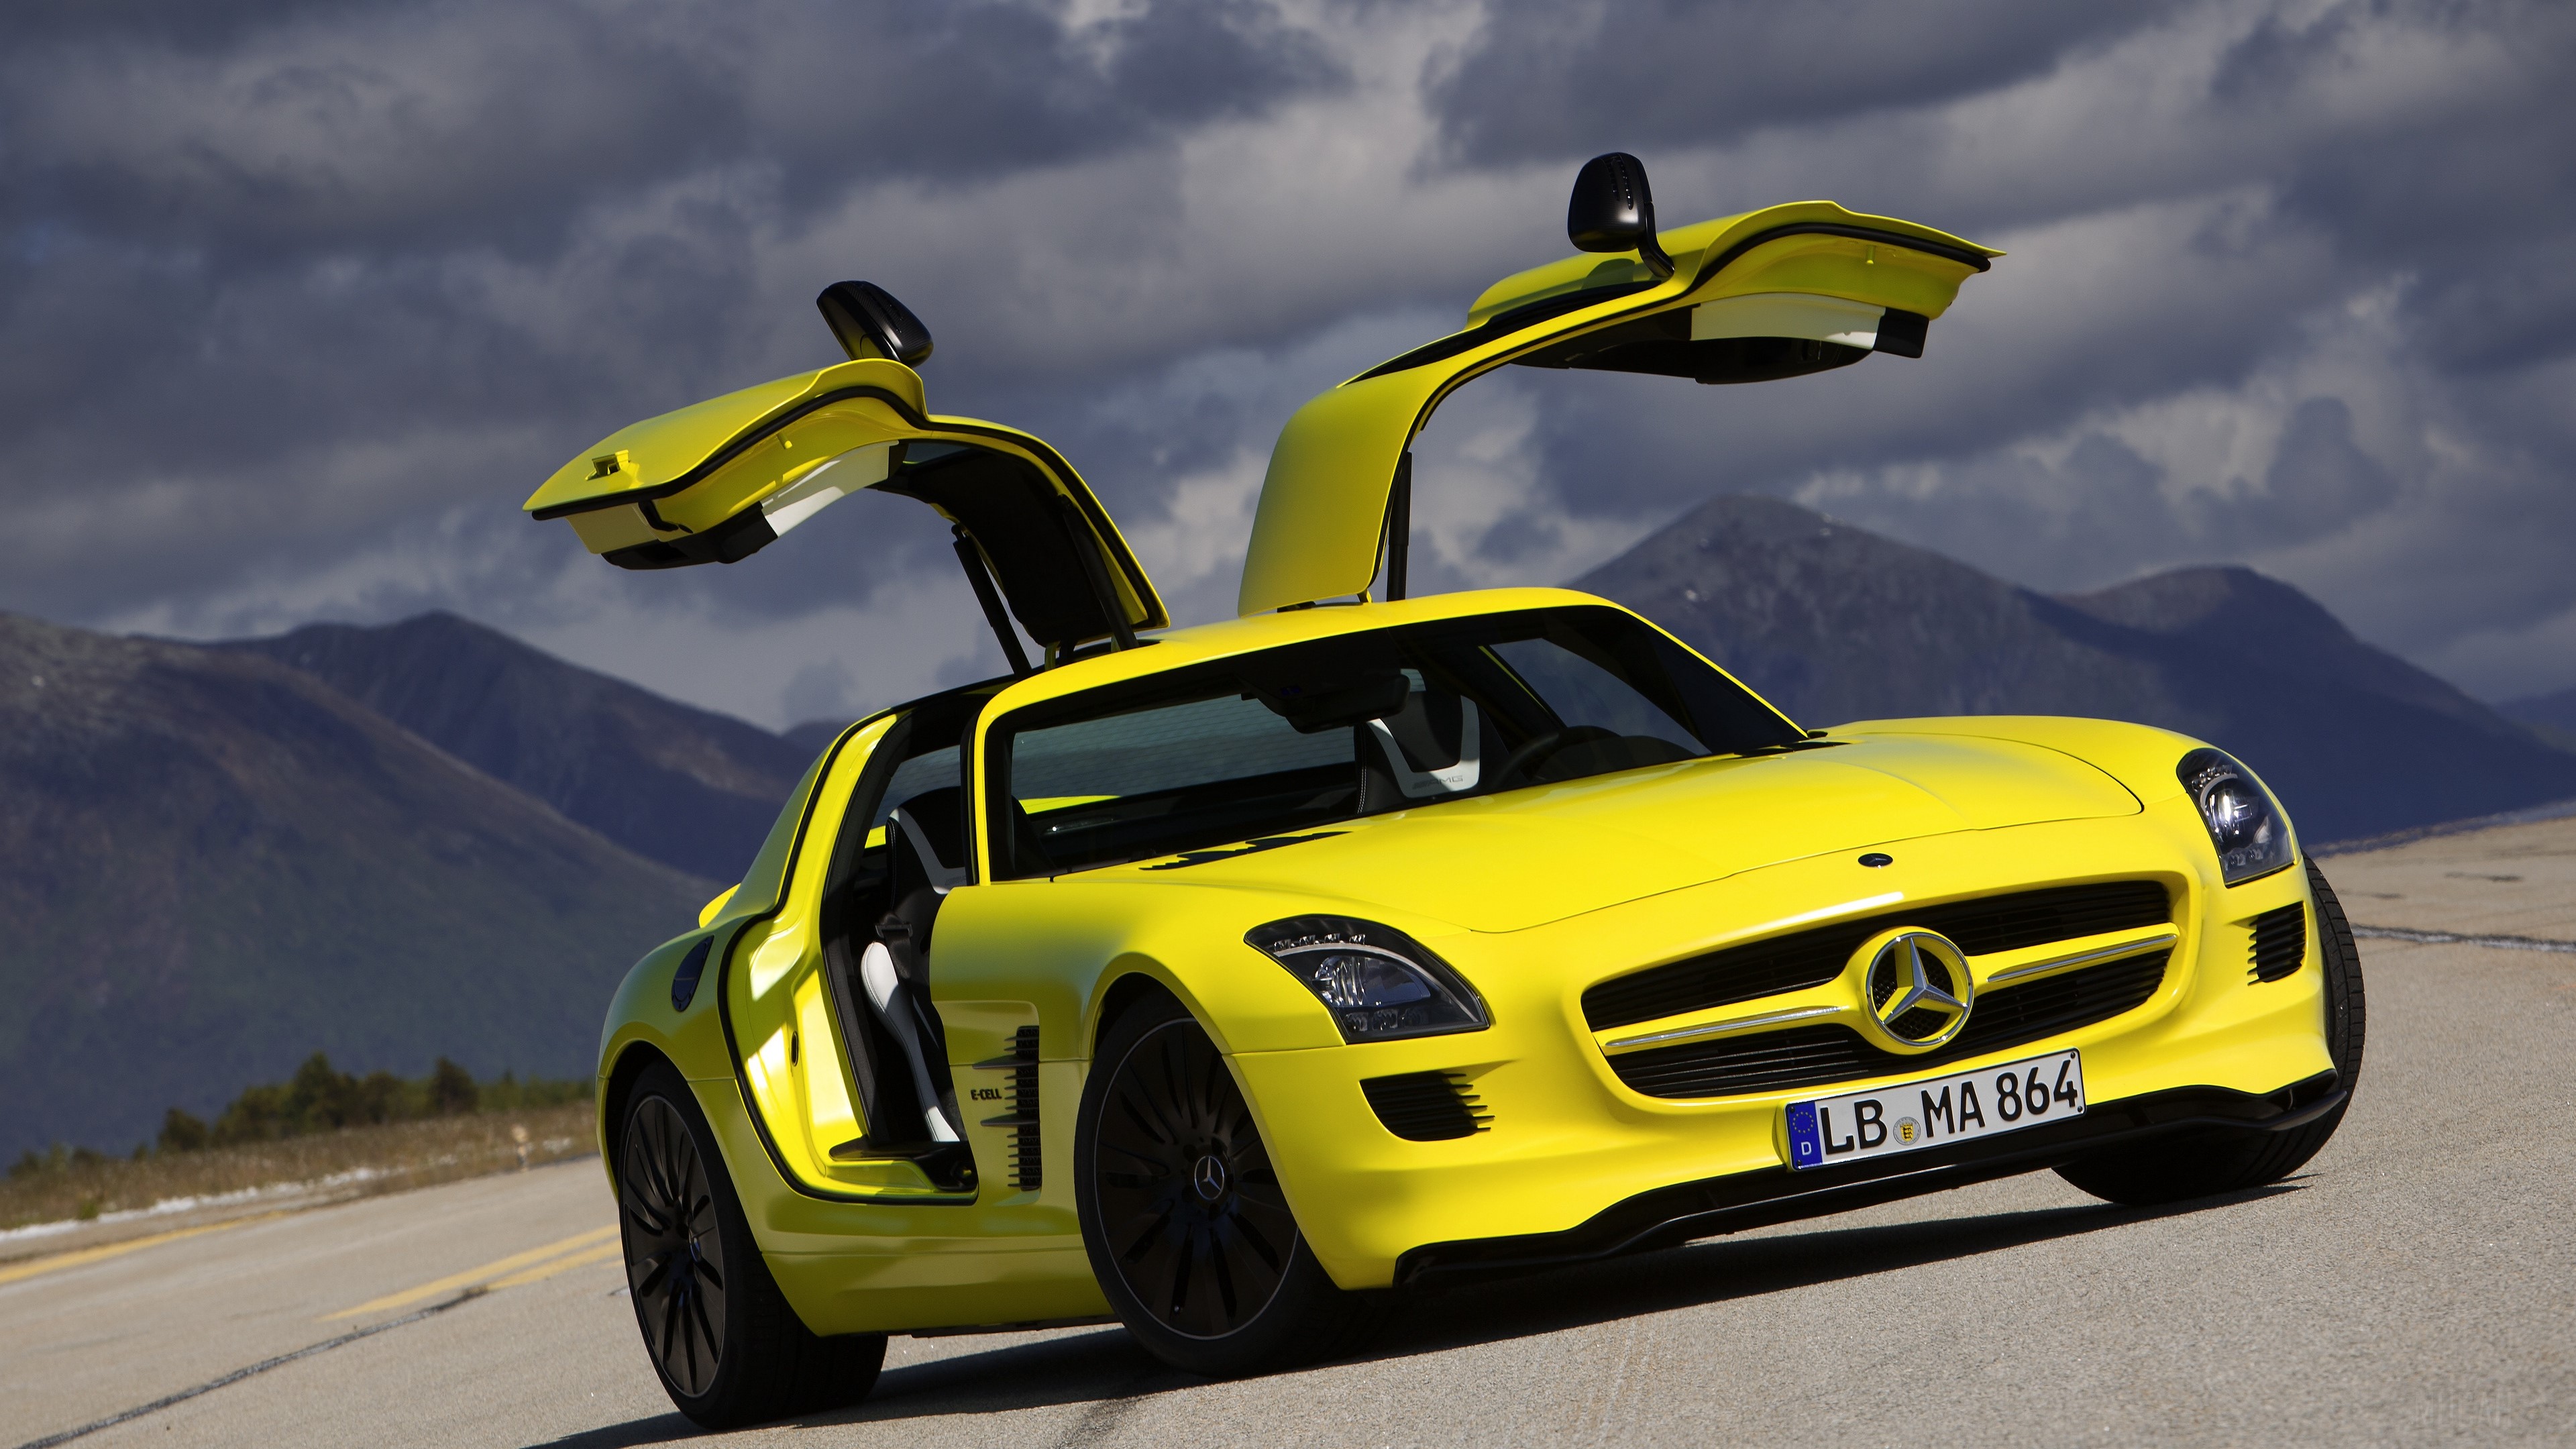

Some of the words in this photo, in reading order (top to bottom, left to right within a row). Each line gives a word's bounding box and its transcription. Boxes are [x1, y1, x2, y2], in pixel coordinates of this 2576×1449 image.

[1425, 775, 1463, 786] AMG
[970, 1088, 1002, 1100] E-CELL
[1820, 1099, 1887, 1155] LB
[1921, 1081, 1986, 1138] MA
[1996, 1060, 2078, 1121] 864
[1801, 1142, 1811, 1155] D
